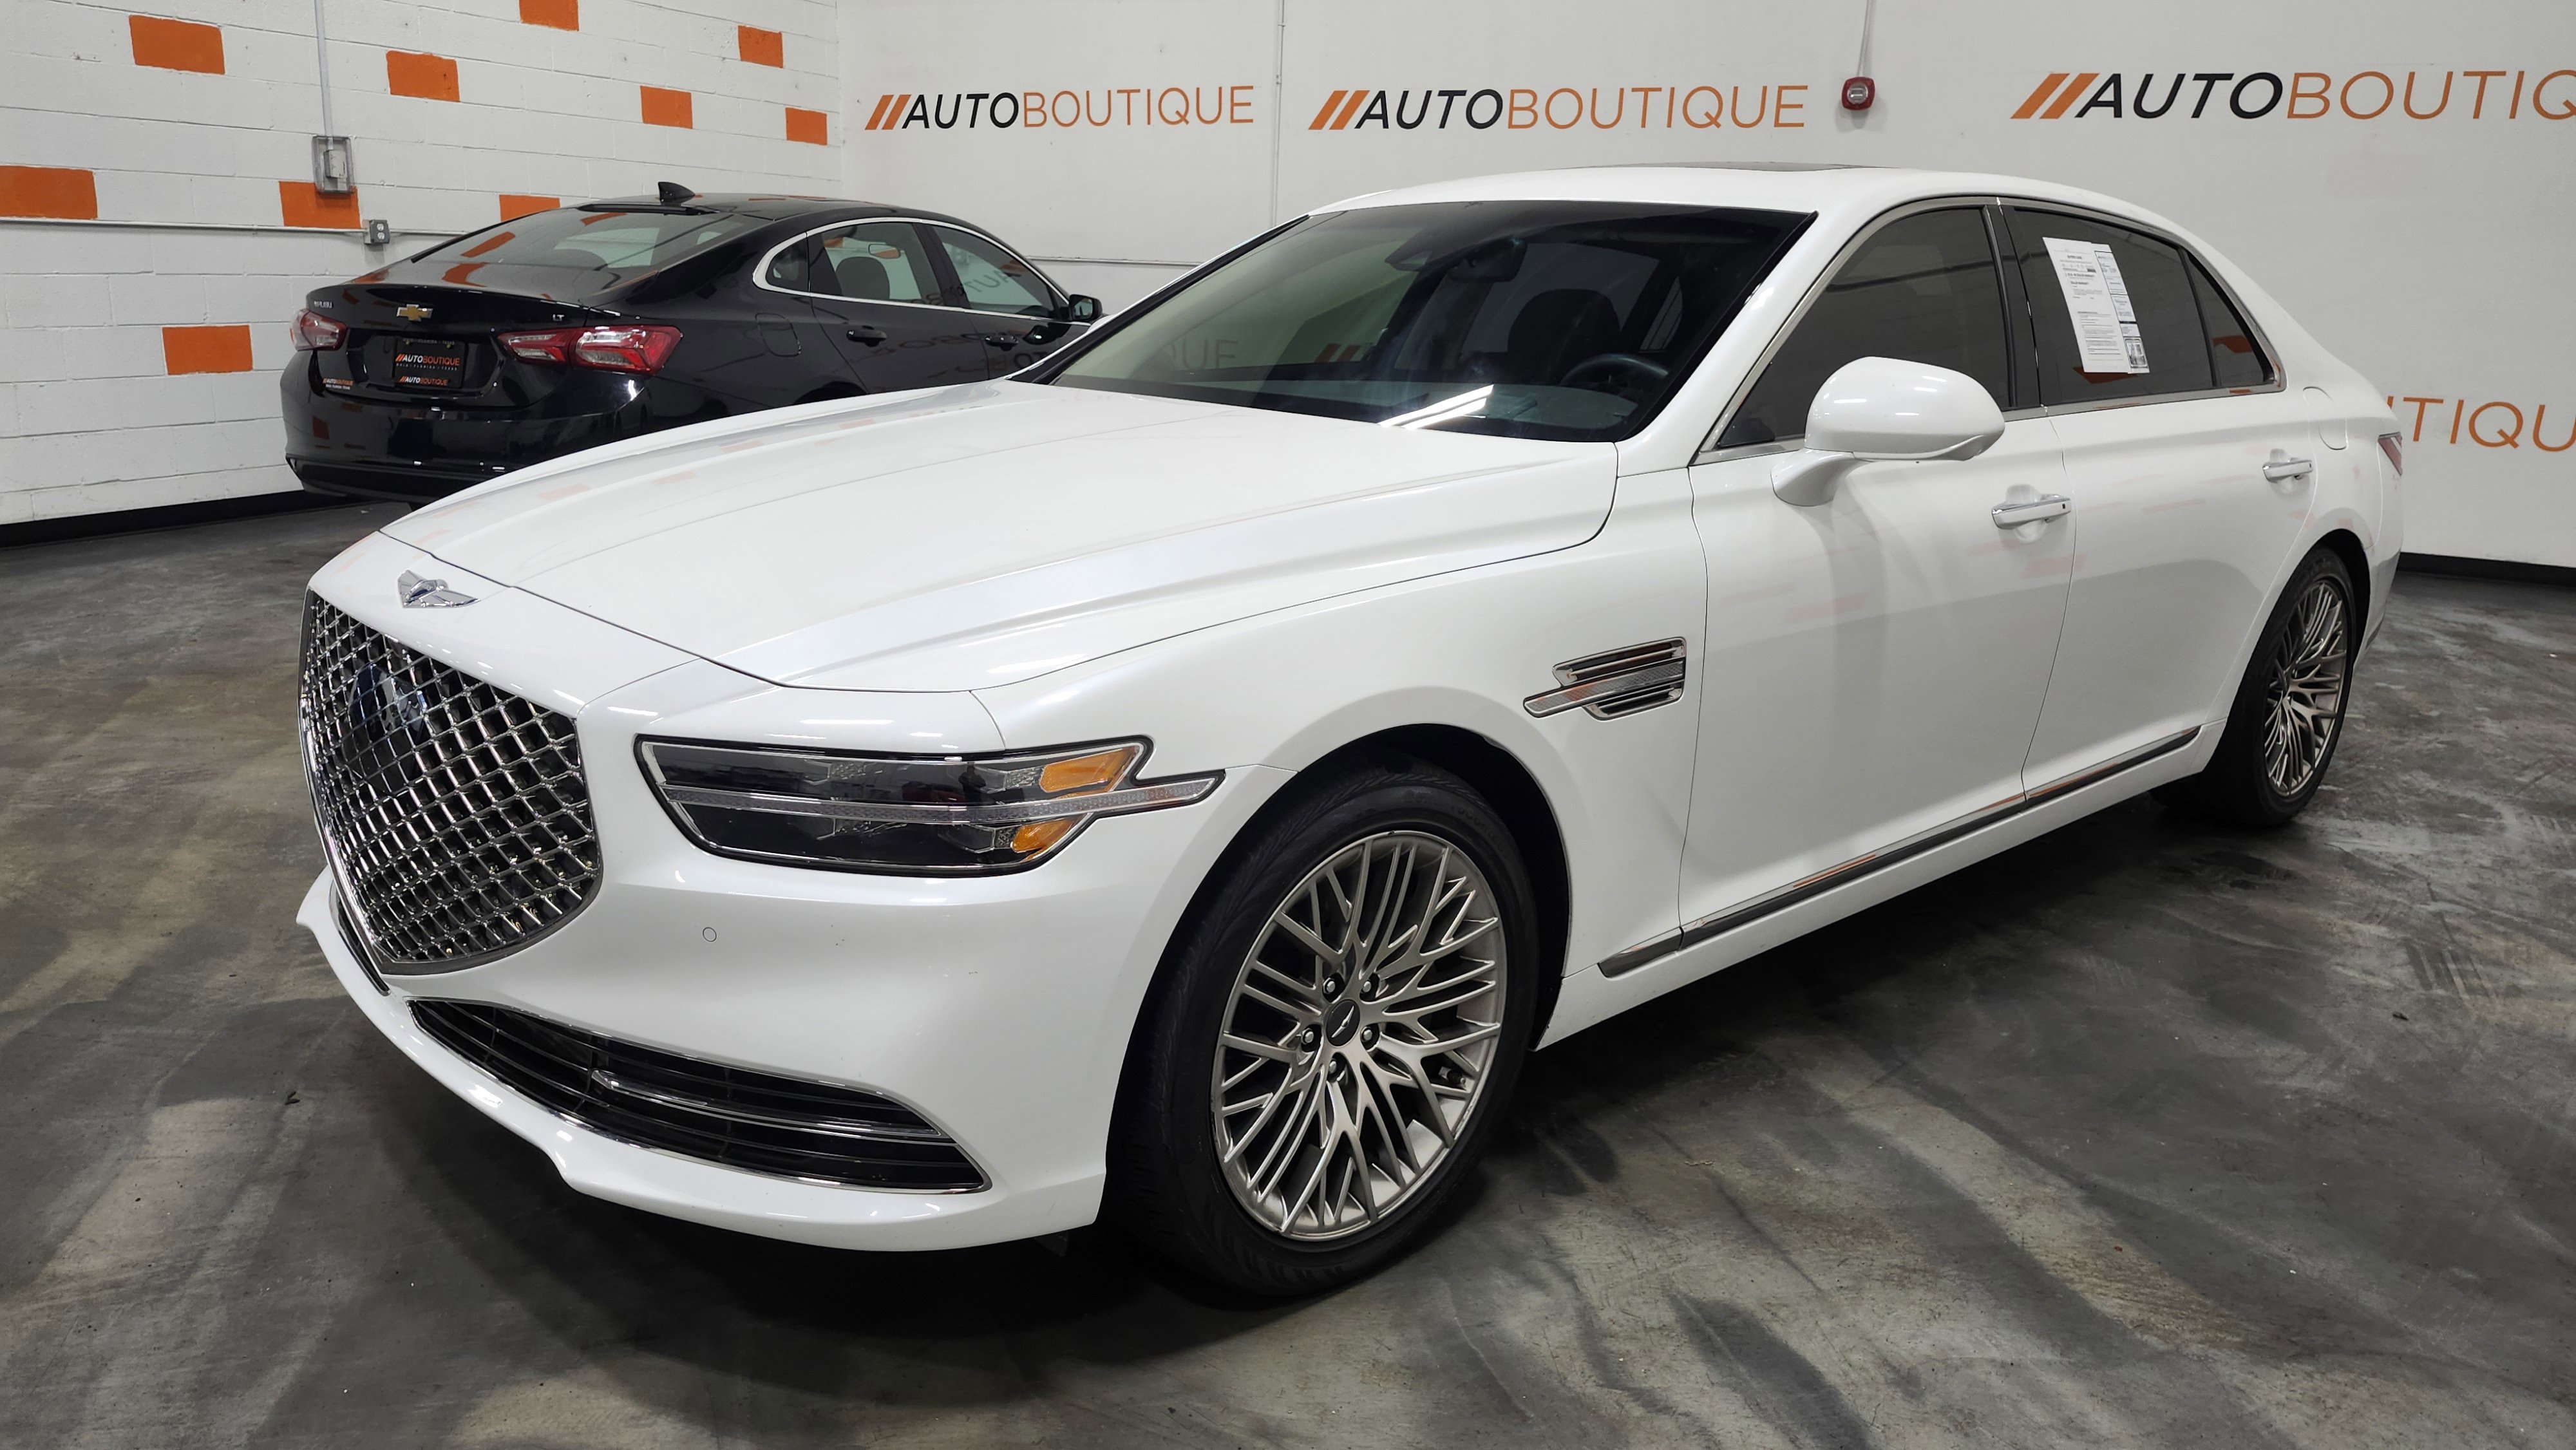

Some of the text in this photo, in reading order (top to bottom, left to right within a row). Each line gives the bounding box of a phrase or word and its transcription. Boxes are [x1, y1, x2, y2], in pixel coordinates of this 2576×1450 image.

[902, 85, 1255, 129] AUTOBOUTIQUE
[1355, 84, 1809, 129] AUTOBOUTIQUE
[553, 314, 565, 322] LT
[402, 354, 460, 366] AUTOBOUTIQUE
[404, 376, 449, 386] AUTOBOUTIQUE
[2387, 395, 2576, 452] TIQU
